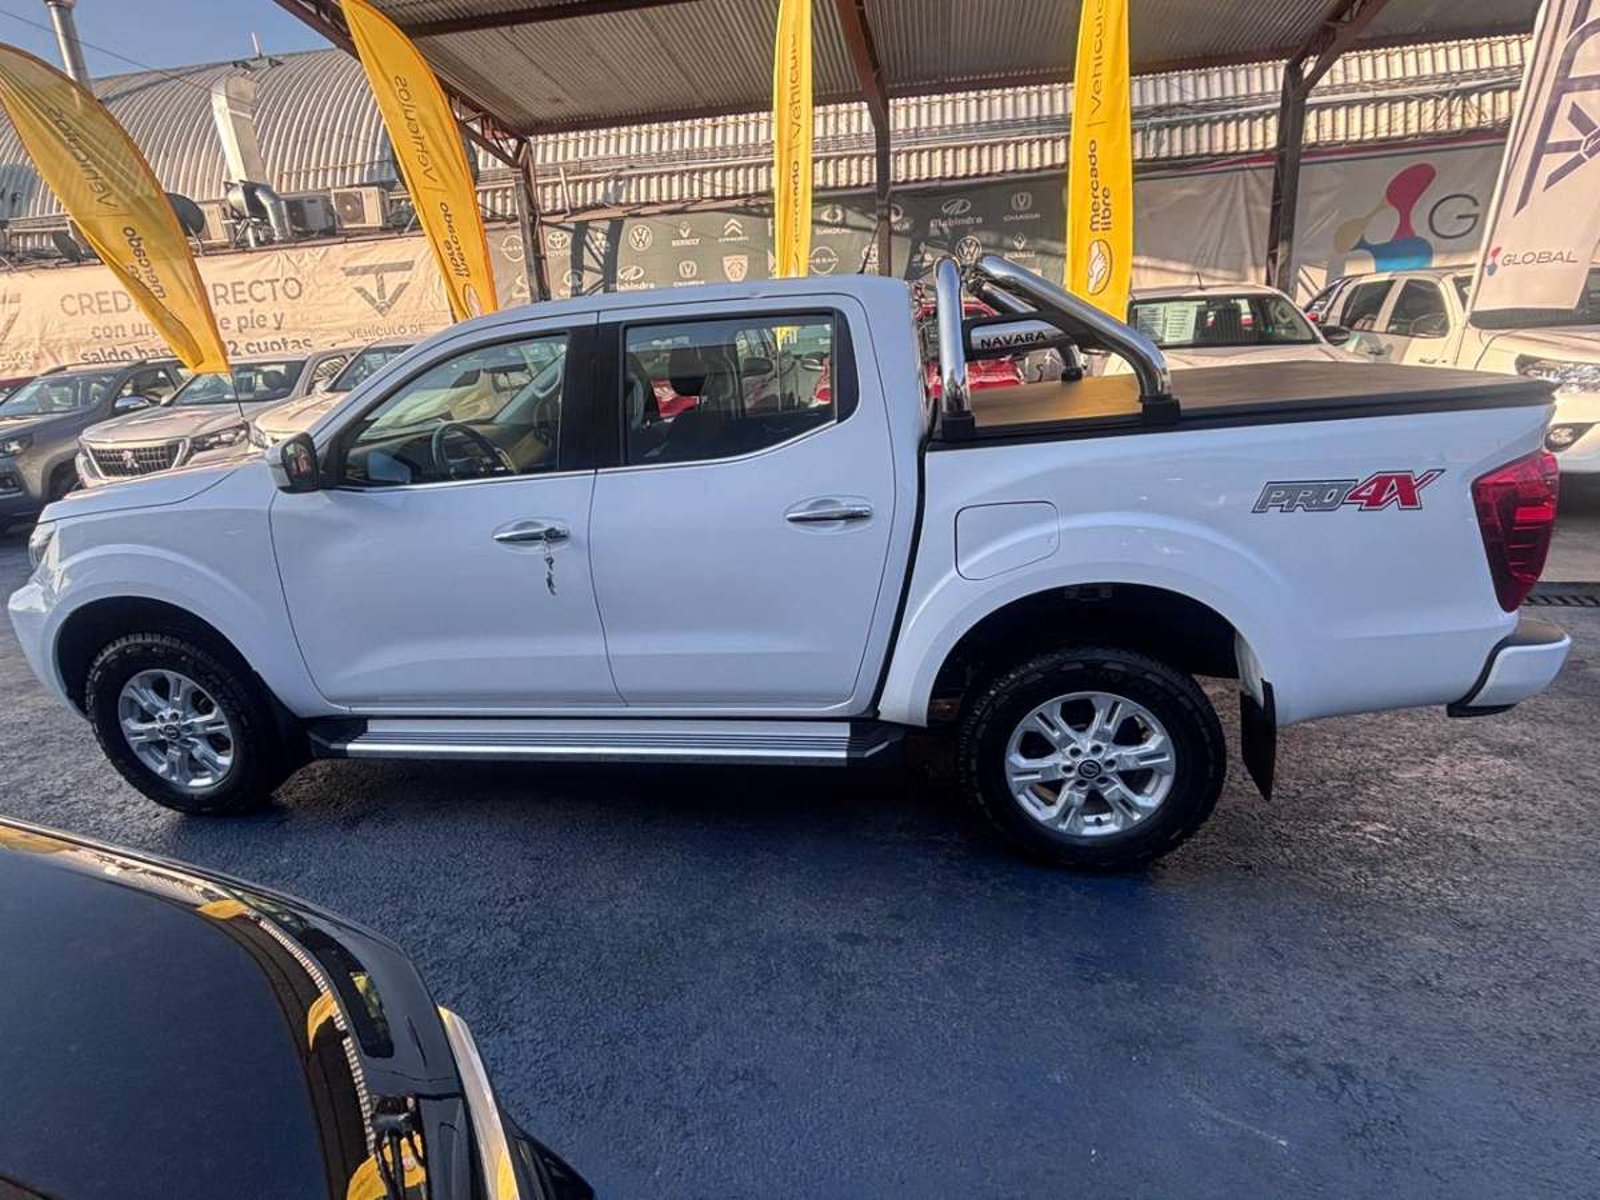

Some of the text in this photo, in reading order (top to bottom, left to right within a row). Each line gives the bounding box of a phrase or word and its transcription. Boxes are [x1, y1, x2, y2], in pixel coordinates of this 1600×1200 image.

[1088, 140, 1100, 232] mercado
[1101, 187, 1111, 231] libre
[1501, 250, 1579, 266] GLOBAL
[60, 277, 302, 316] CRED RECTO
[91, 324, 127, 339] con
[237, 308, 268, 333] pie
[273, 312, 284, 331] y
[980, 330, 1047, 349] NAVARA
